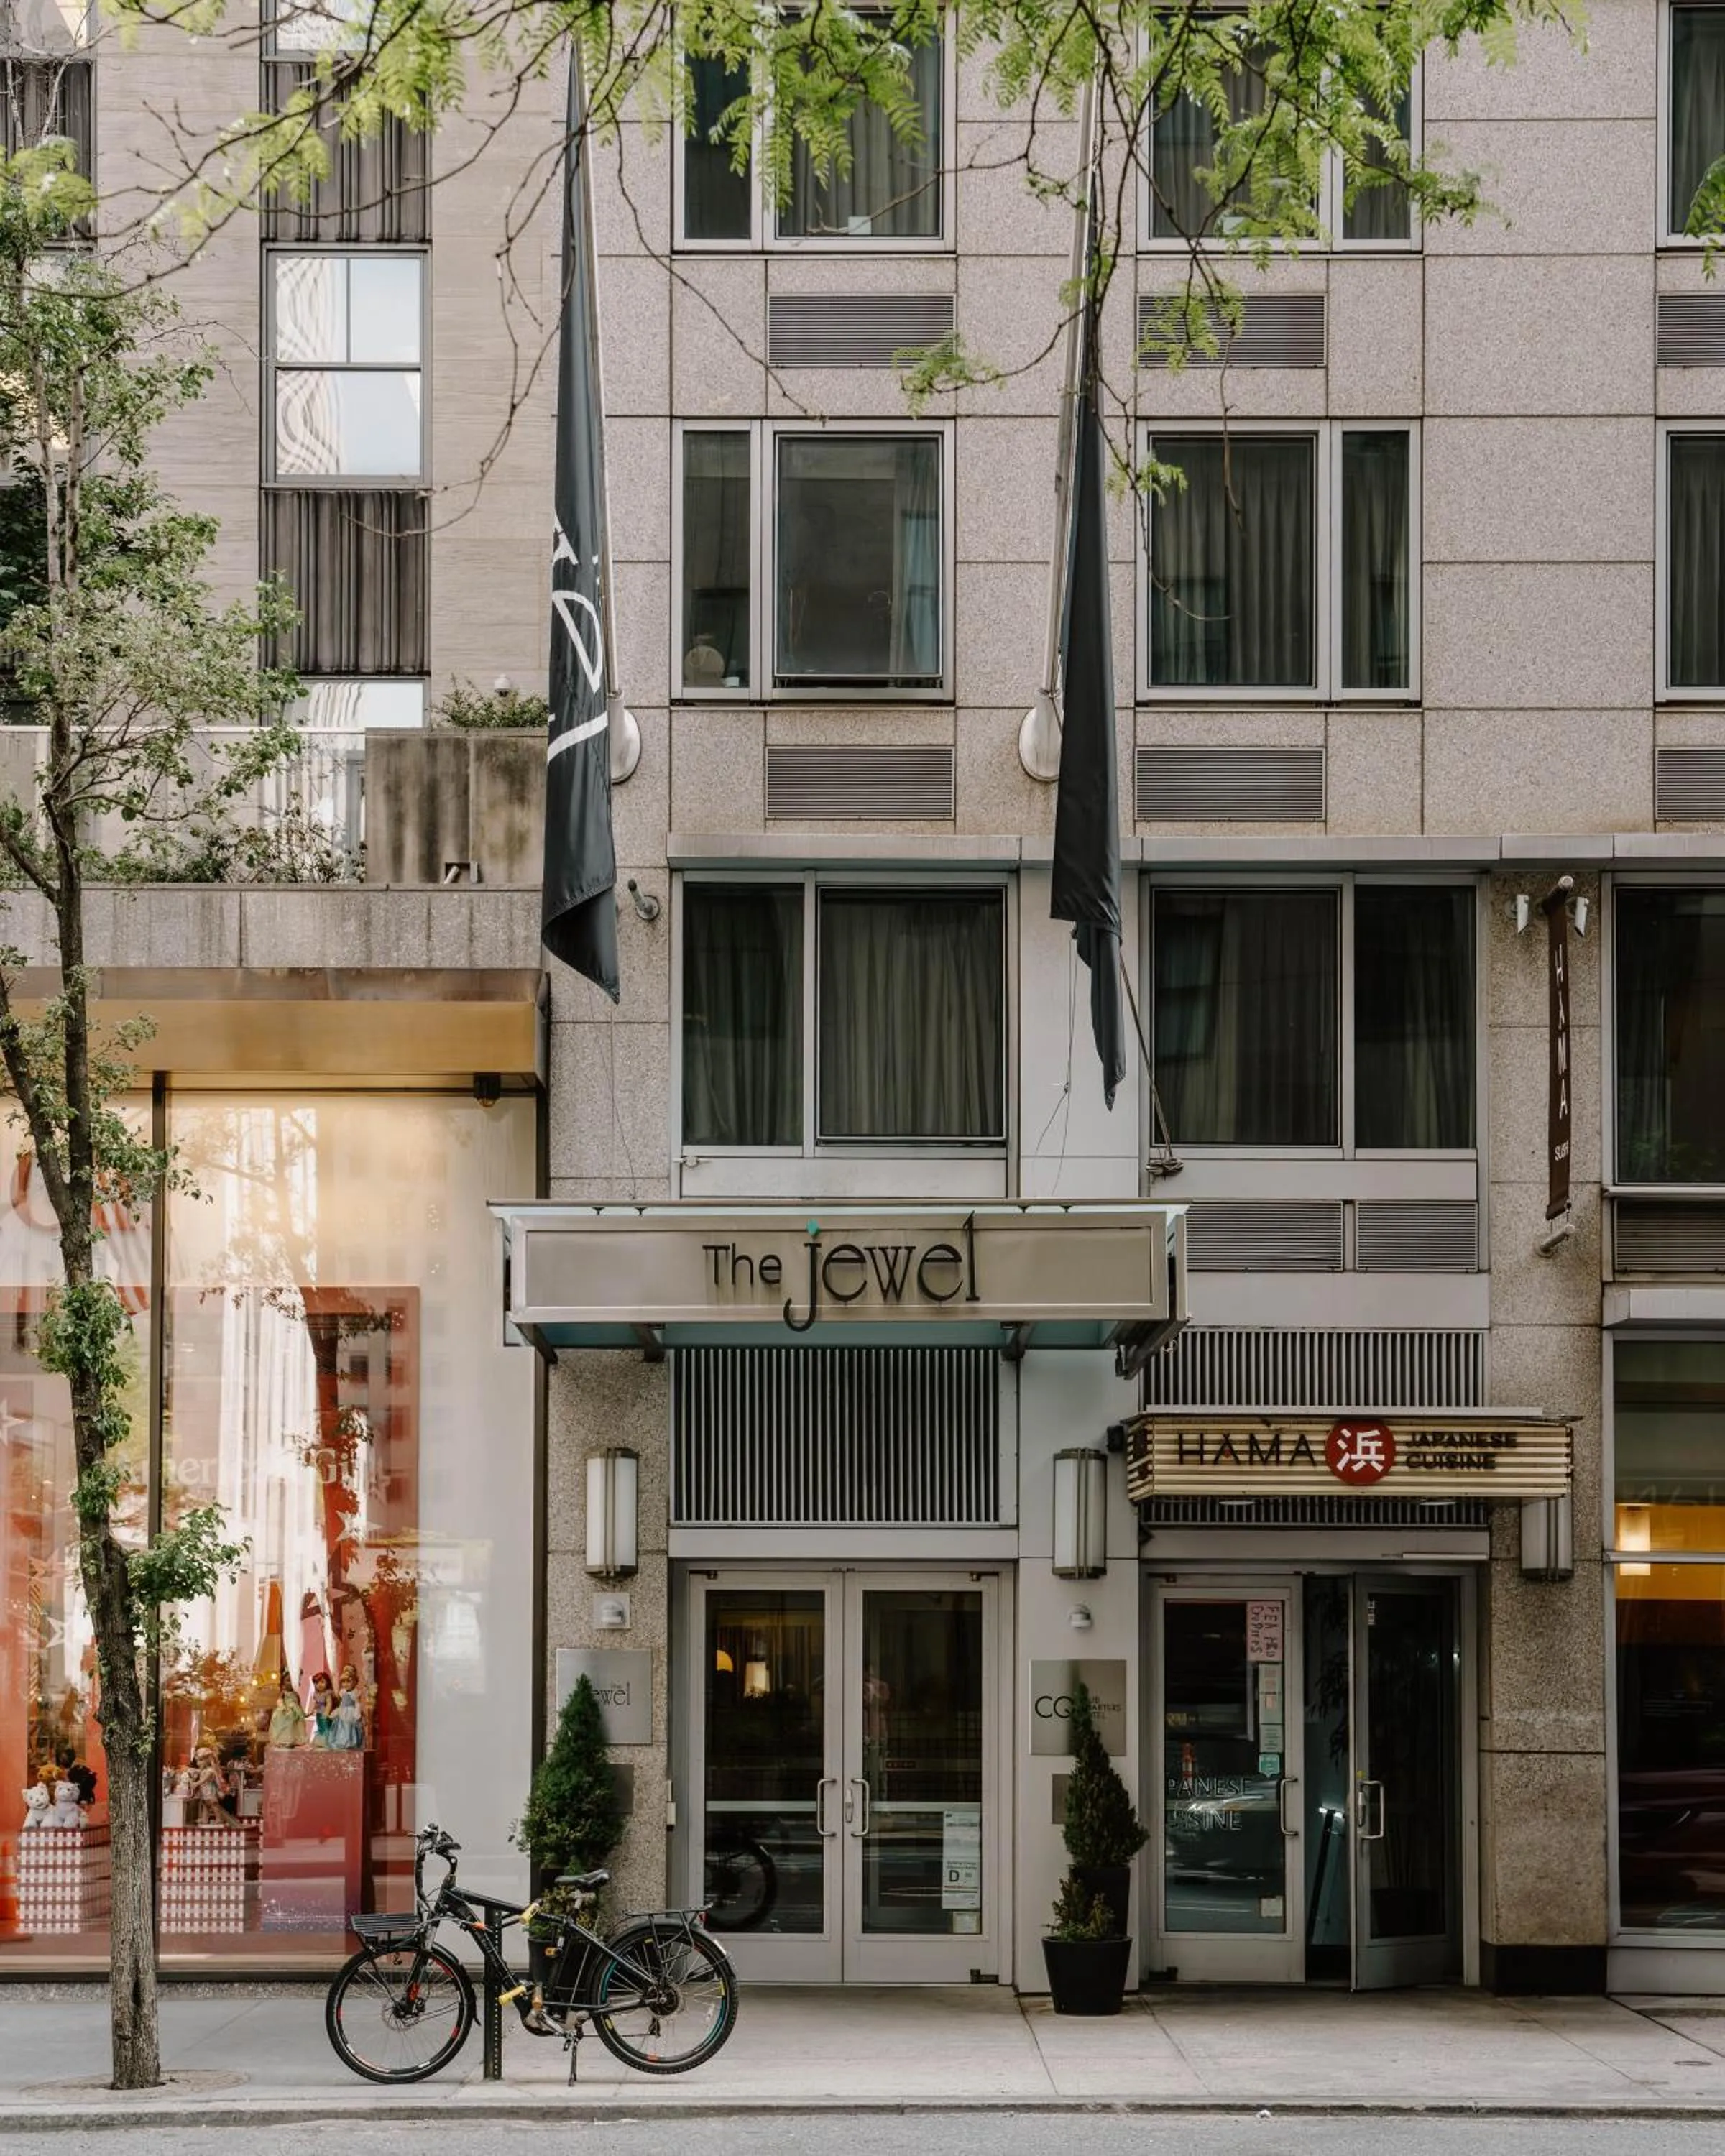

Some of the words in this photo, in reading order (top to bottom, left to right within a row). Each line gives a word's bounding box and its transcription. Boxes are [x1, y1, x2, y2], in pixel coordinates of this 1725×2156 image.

[702, 1242, 783, 1286] The
[1178, 1432, 1317, 1466] HAMA
[1335, 1427, 1386, 1473] 浜
[1407, 1432, 1518, 1448] JAPANESE
[1407, 1452, 1496, 1470] CUISINE
[591, 1681, 631, 1706] wel
[1034, 1695, 1075, 1718] CQ
[949, 1869, 960, 1882] D
